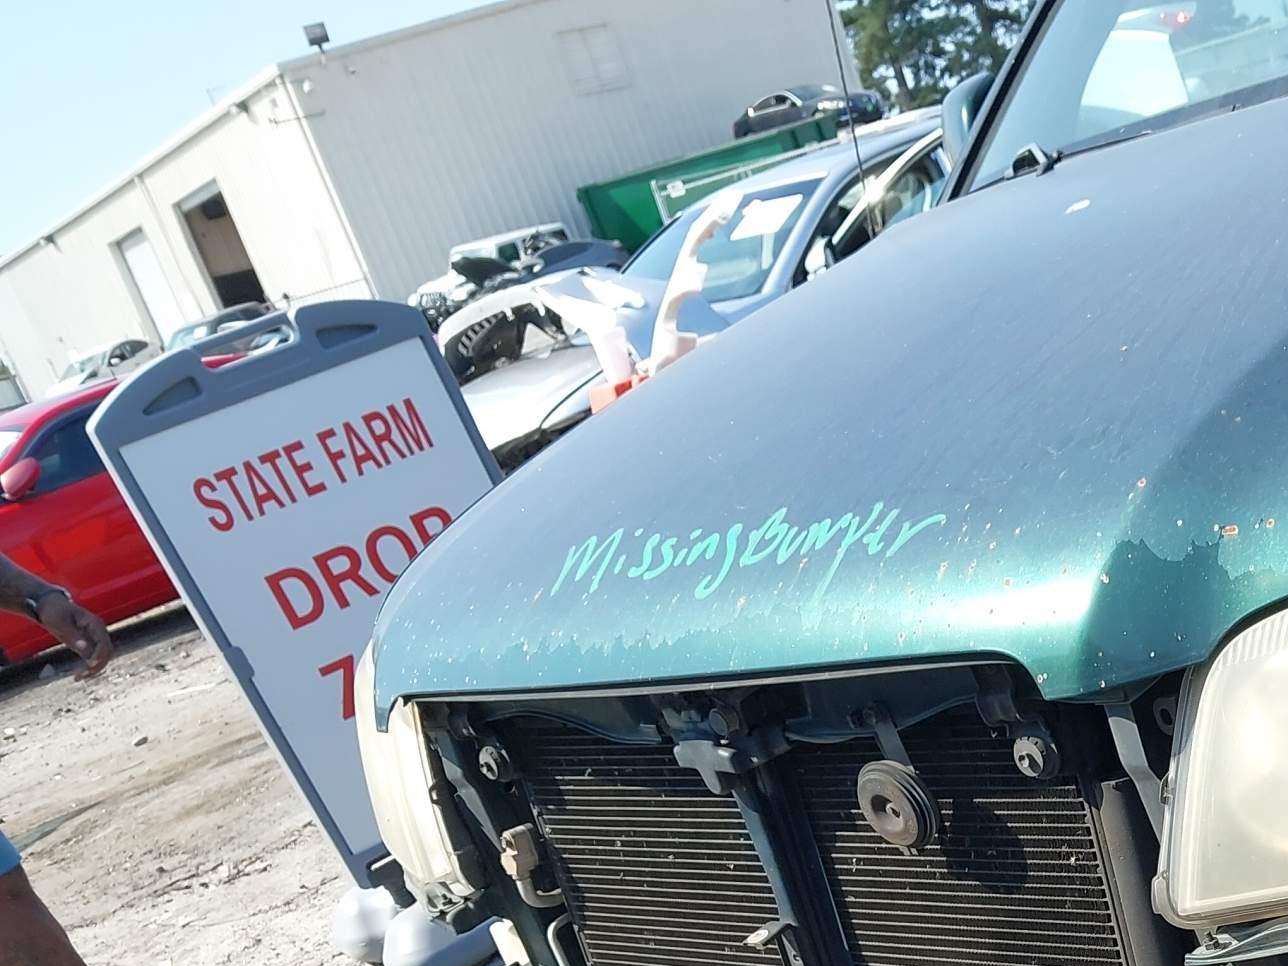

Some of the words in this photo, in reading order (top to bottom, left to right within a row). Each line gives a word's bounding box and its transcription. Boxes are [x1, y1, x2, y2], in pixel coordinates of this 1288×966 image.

[193, 440, 327, 532] STATE
[316, 397, 434, 484] FARM
[550, 523, 743, 600] Missing
